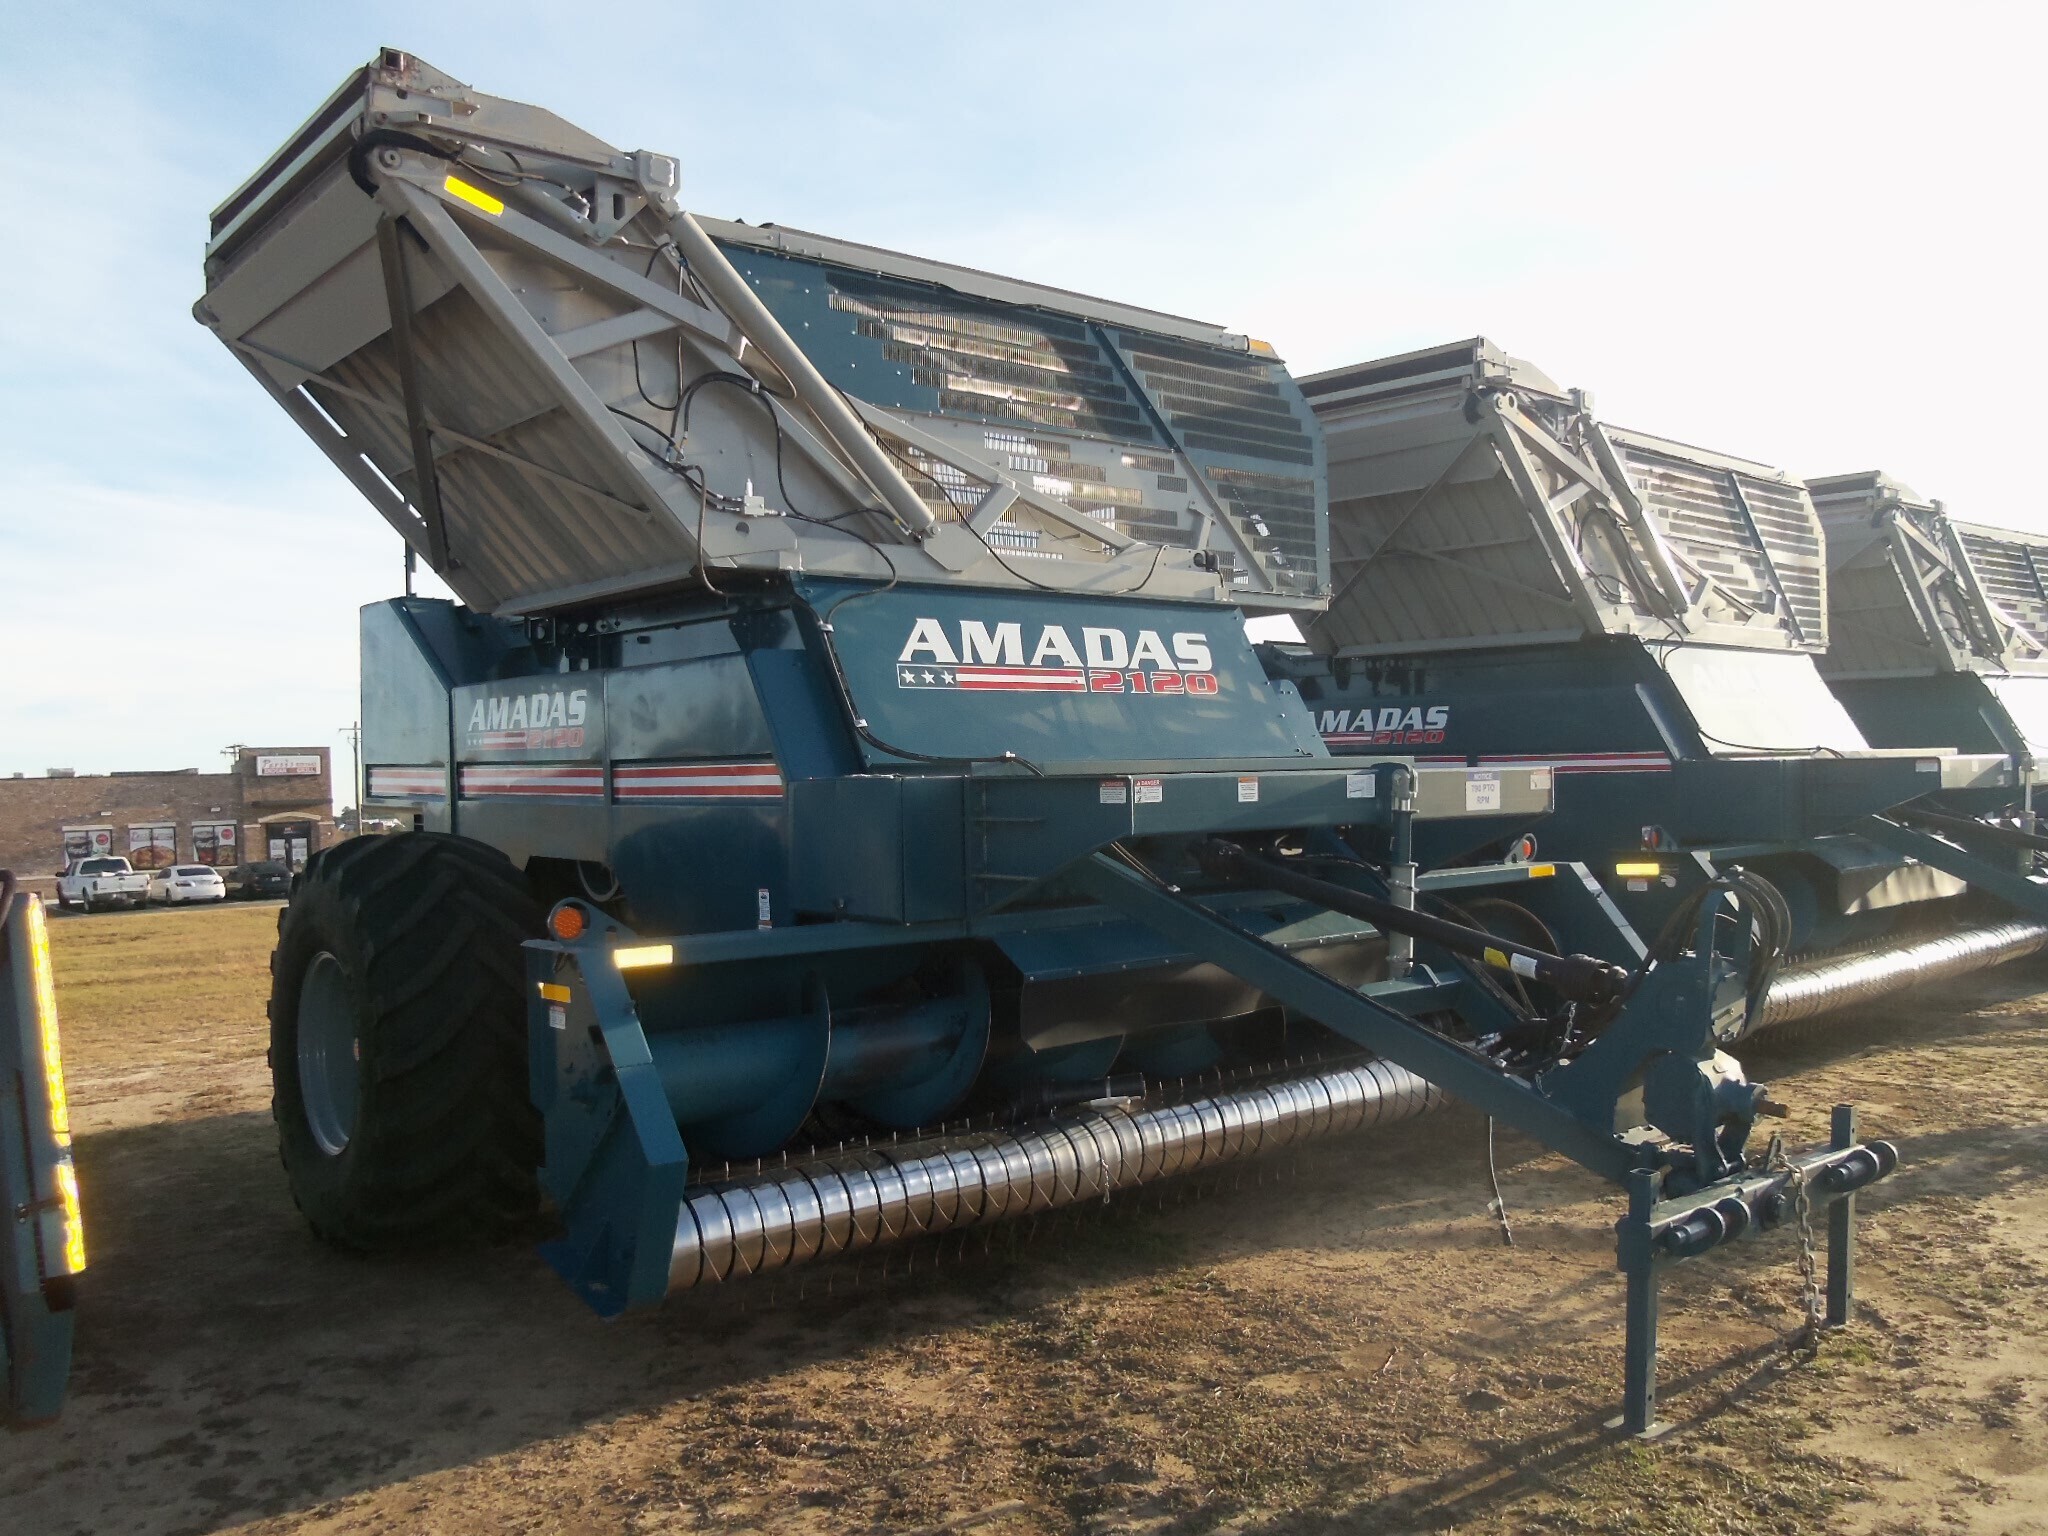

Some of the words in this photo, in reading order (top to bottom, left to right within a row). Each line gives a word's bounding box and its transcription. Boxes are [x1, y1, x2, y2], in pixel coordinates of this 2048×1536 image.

[897, 617, 1213, 672] AMADAS
[1089, 669, 1219, 695] 2120
[467, 689, 588, 732] AMADAS
[526, 727, 585, 749] 2120
[1372, 729, 1446, 745] 2120
[1482, 783, 1495, 792] PTO
